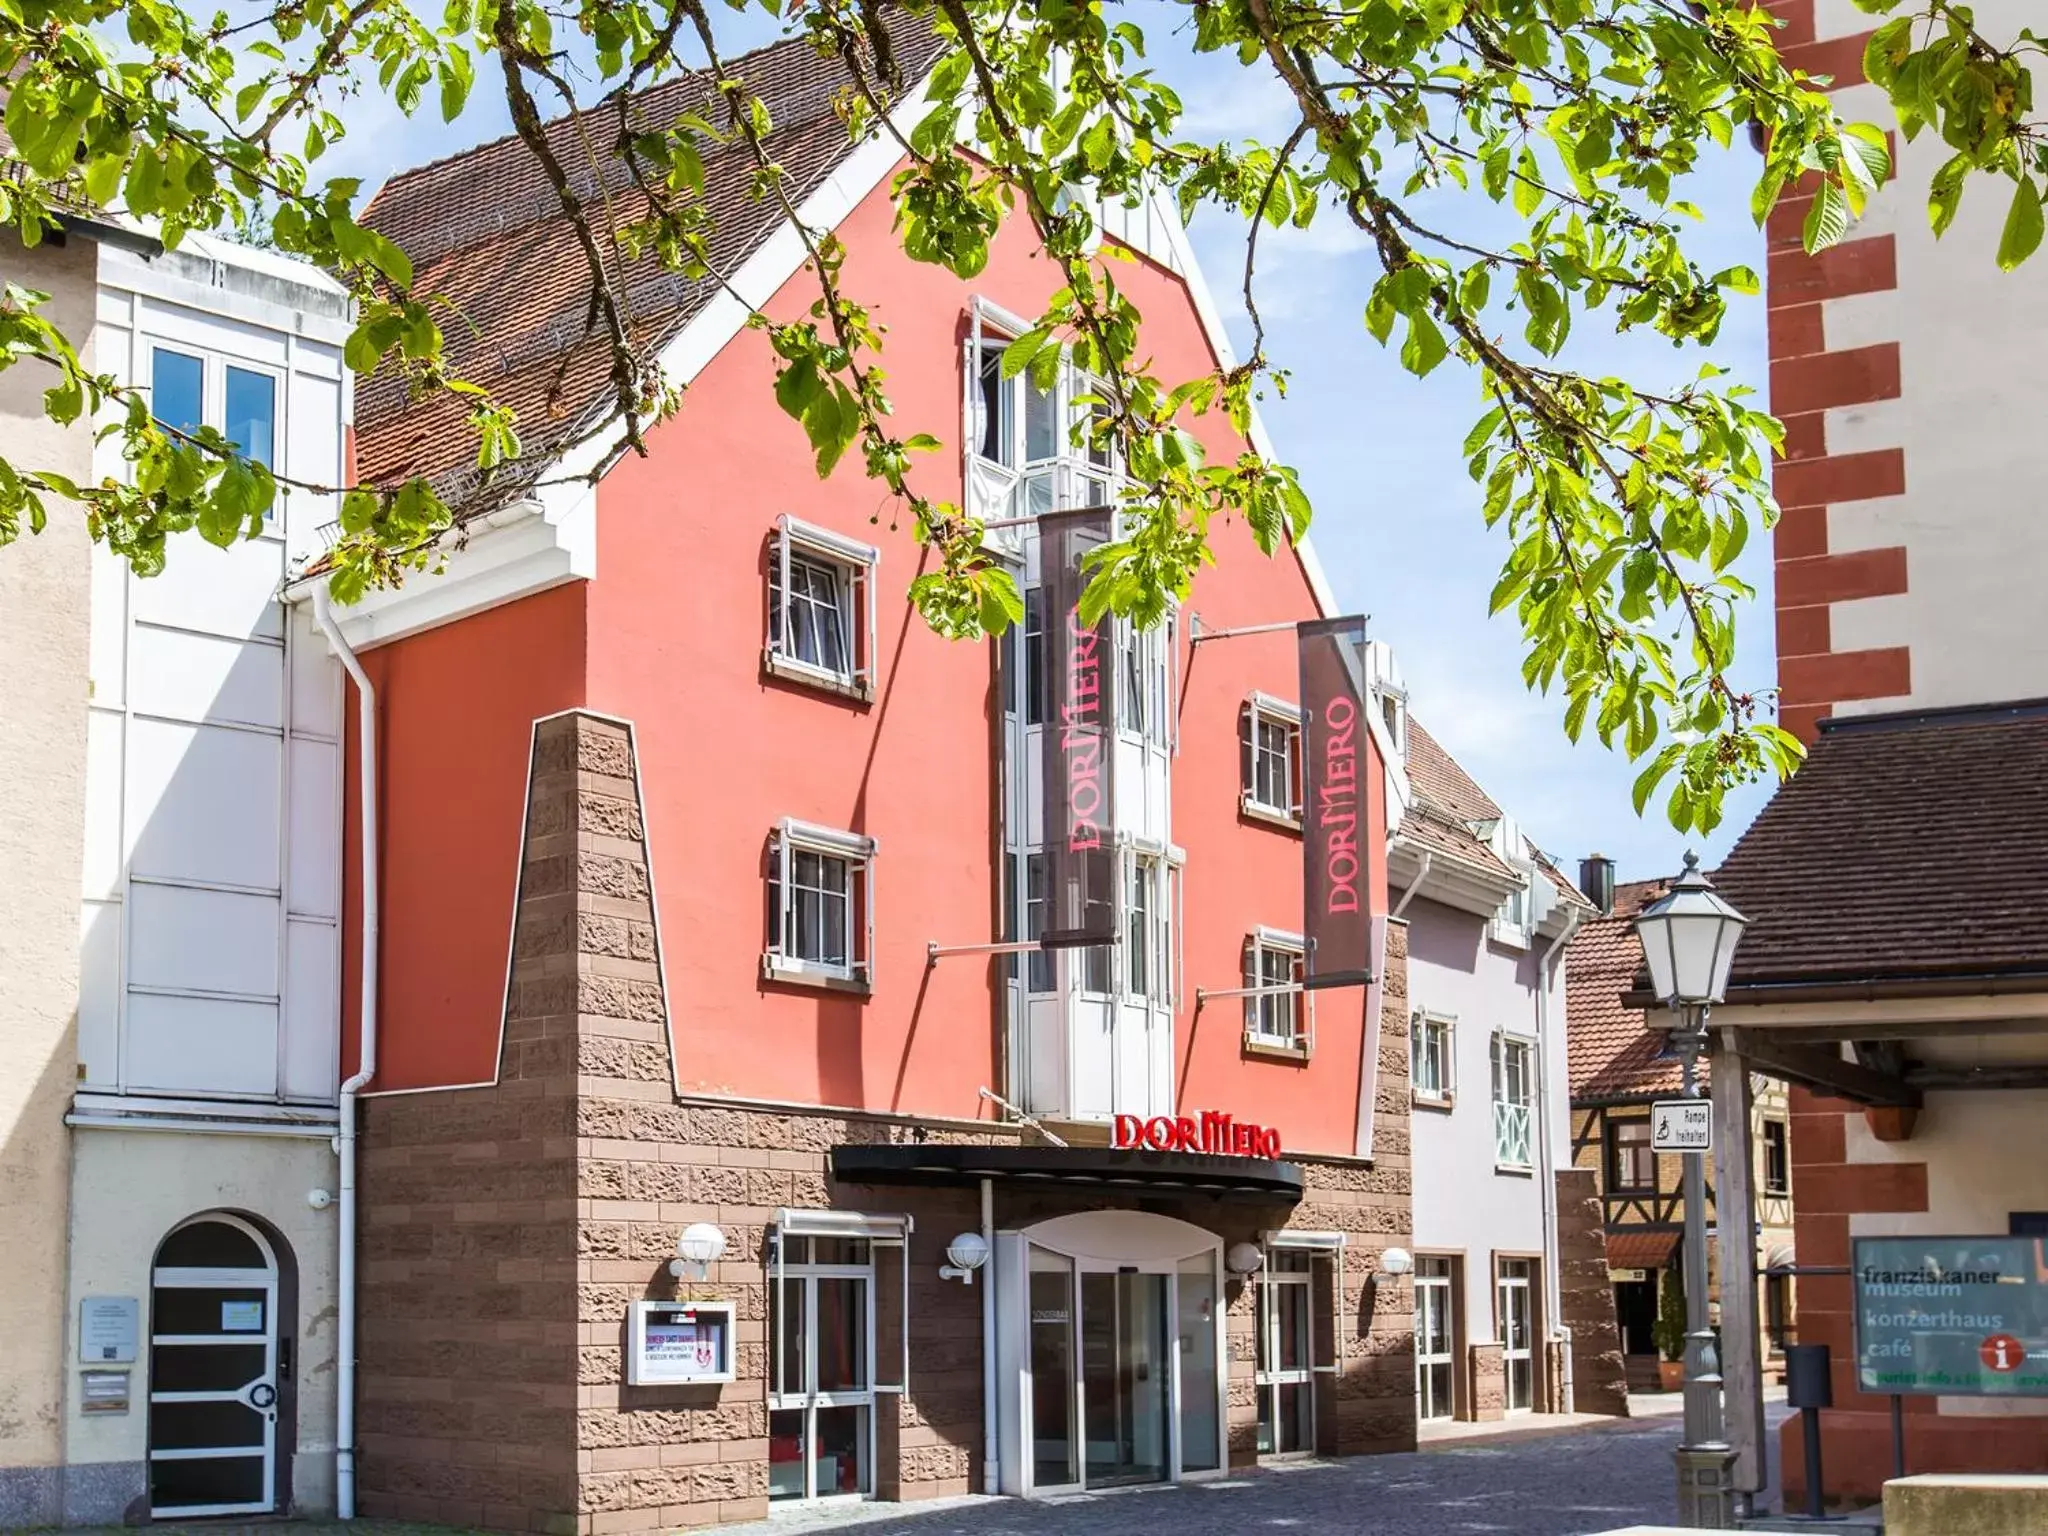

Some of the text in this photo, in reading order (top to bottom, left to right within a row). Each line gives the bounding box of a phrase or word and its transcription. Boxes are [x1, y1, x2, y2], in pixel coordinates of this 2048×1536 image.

[1320, 696, 1359, 914] DORMERO
[1684, 1109, 1705, 1123] Rampe
[1112, 1110, 1281, 1160] DORMERO
[1865, 1266, 1999, 1285] franziskaner
[1865, 1283, 1962, 1297] museum
[1866, 1309, 2003, 1329] konzerthaus
[1868, 1337, 1912, 1357] café
